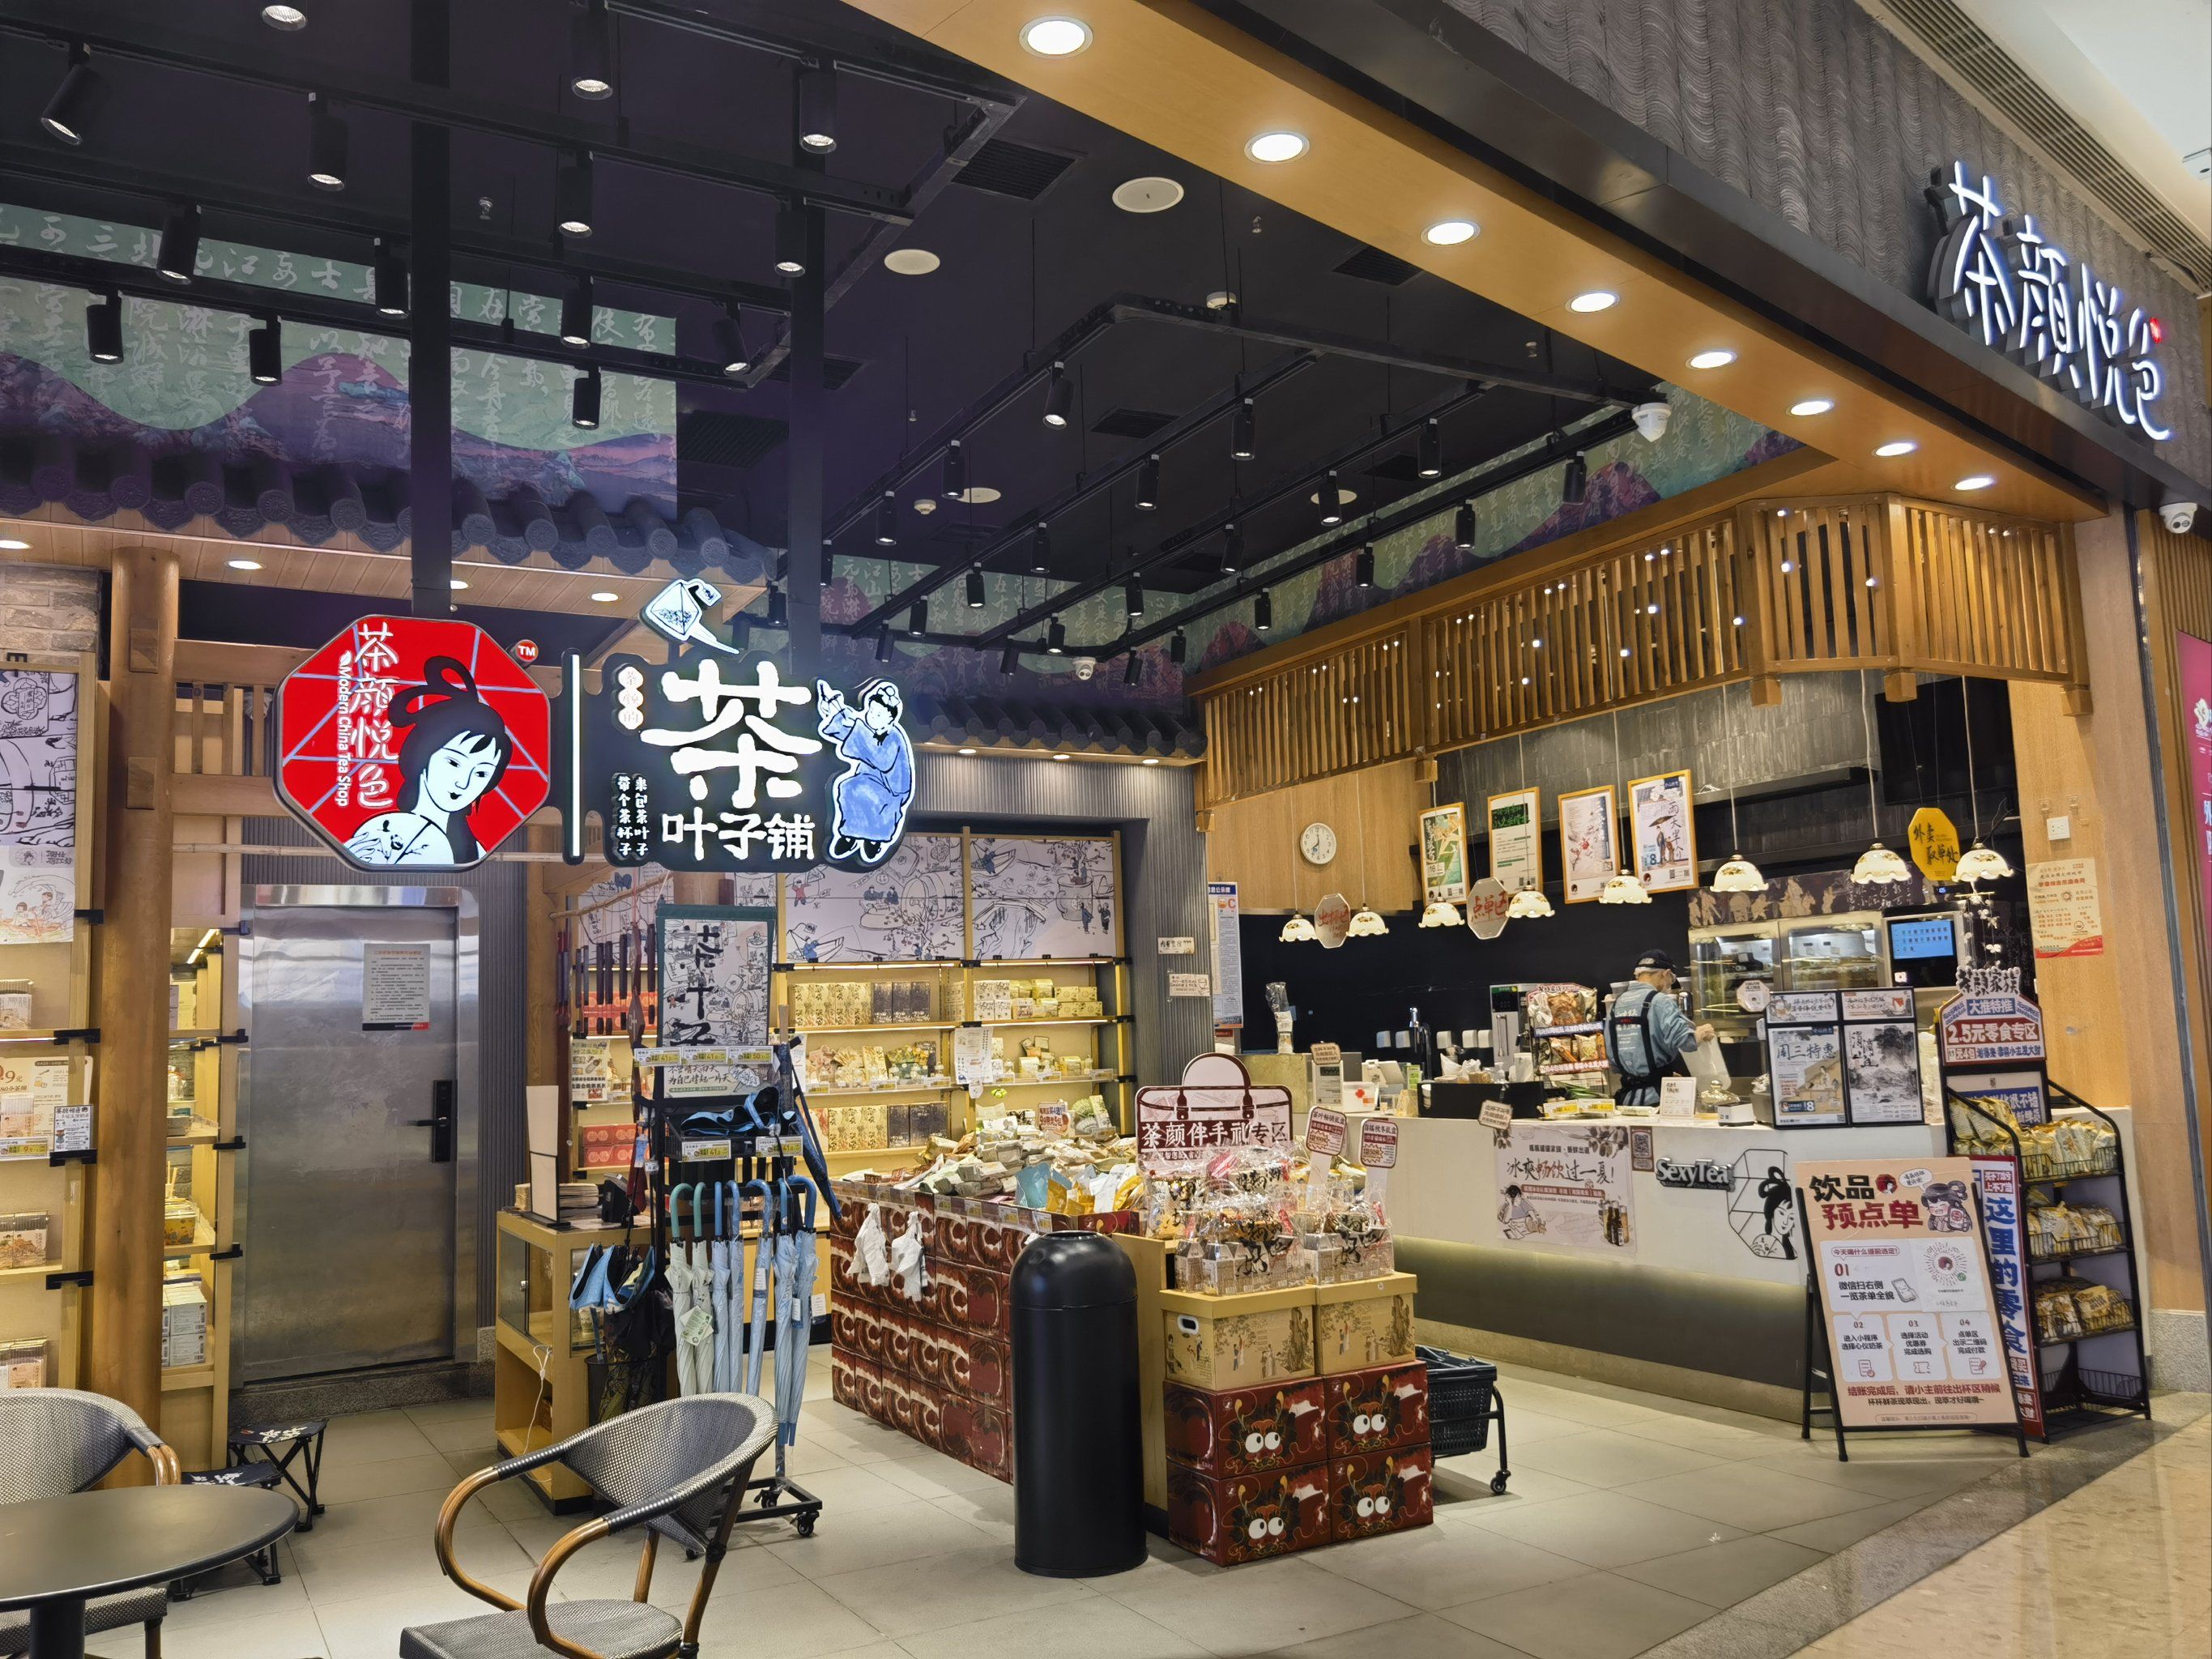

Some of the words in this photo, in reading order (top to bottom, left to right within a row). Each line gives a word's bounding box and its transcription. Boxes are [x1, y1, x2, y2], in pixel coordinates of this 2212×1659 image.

[1949, 160, 2172, 440] 茶颜悦色
[338, 666, 352, 714] Modern
[349, 621, 399, 808] 茶颜悦色
[338, 716, 352, 749] China
[641, 659, 822, 809] 茶
[338, 752, 352, 774] Tea
[335, 775, 352, 807] Shop
[616, 775, 633, 855] 带个茶杯子
[634, 776, 649, 856] 来包茶叶子
[661, 808, 815, 860] 叶子铺
[1913, 822, 1934, 844] 外卖
[1650, 854, 1656, 865] 8
[1228, 898, 1236, 908] C
[1473, 891, 1507, 919] 点单区
[1948, 1022, 2037, 1043] 2.5元零食专区
[1776, 1043, 1836, 1060] 周三特惠
[1807, 1102, 1814, 1111] 8
[1142, 1121, 1288, 1147] 茶颜伴手礼专区
[1656, 1158, 1729, 1187] SexyTea
[1809, 1175, 1875, 1202] 饮品
[1821, 1200, 1924, 1230] 预点单
[1835, 1263, 1849, 1277] 01
[1984, 1196, 2027, 1354] 这里的零食
[1839, 1281, 1883, 1290] 微信扫右侧
[1840, 1290, 1894, 1301] 一览茶单全貌
[1841, 1342, 1883, 1350] 选择心仪奶茶
[1958, 1346, 1985, 1354] 完成付款
